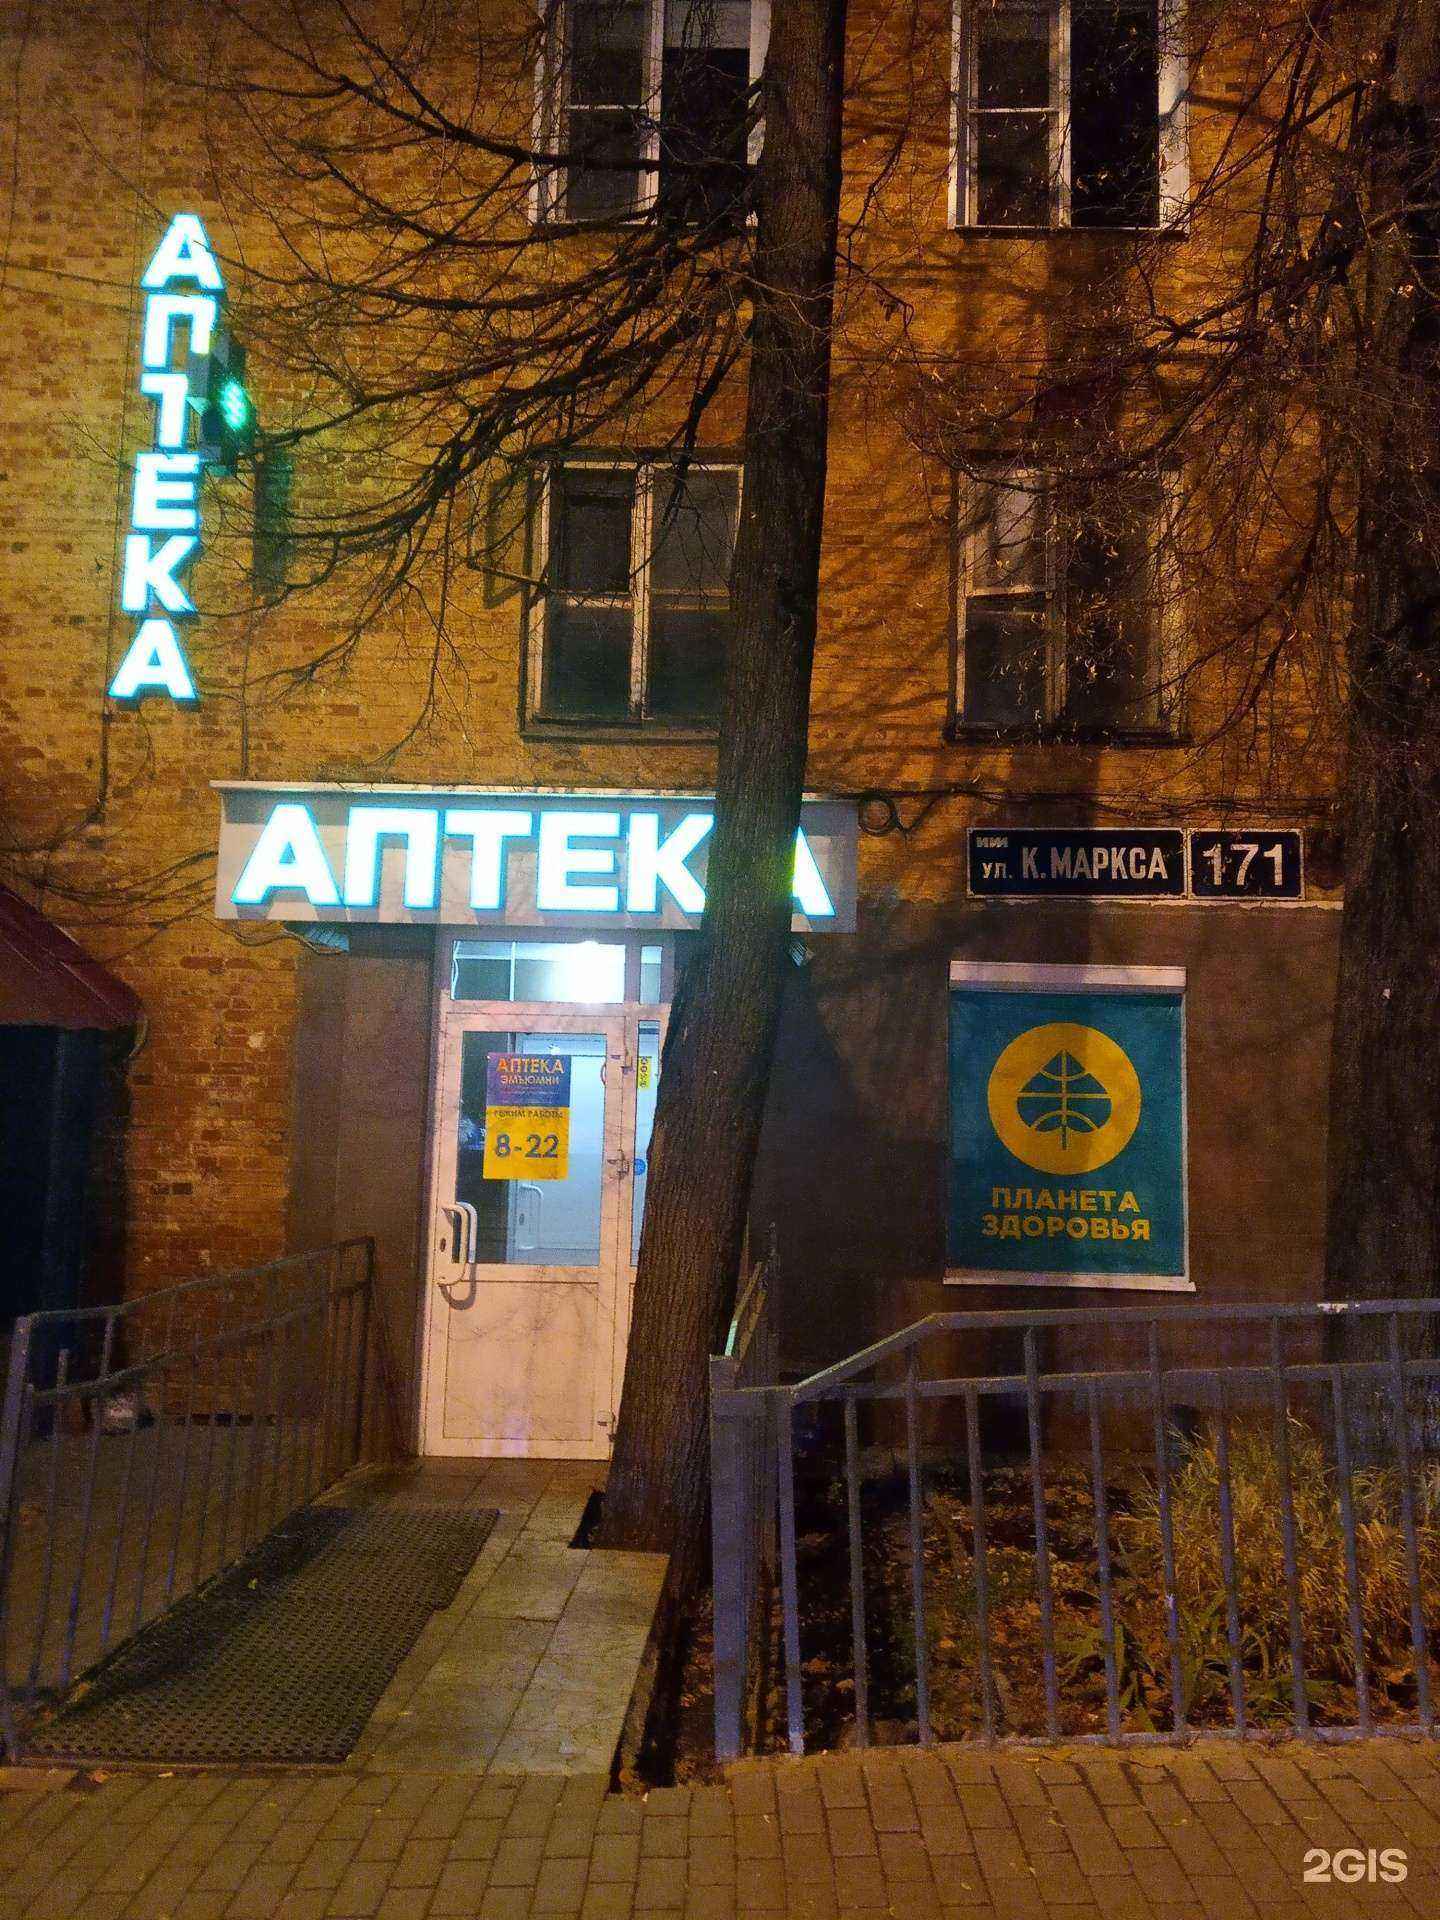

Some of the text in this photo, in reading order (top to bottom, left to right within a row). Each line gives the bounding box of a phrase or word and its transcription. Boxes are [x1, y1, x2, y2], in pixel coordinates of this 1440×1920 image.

[108, 212, 225, 701] АПТЕКА
[982, 862, 1012, 879] ул.
[1202, 843, 1283, 887] 171
[496, 1057, 565, 1074] АПТЕКА
[496, 1133, 560, 1159] 8-22
[991, 1187, 1141, 1213] ПЛАНЕТА
[982, 1214, 1151, 1241] ЗДОРОВЬЯ
